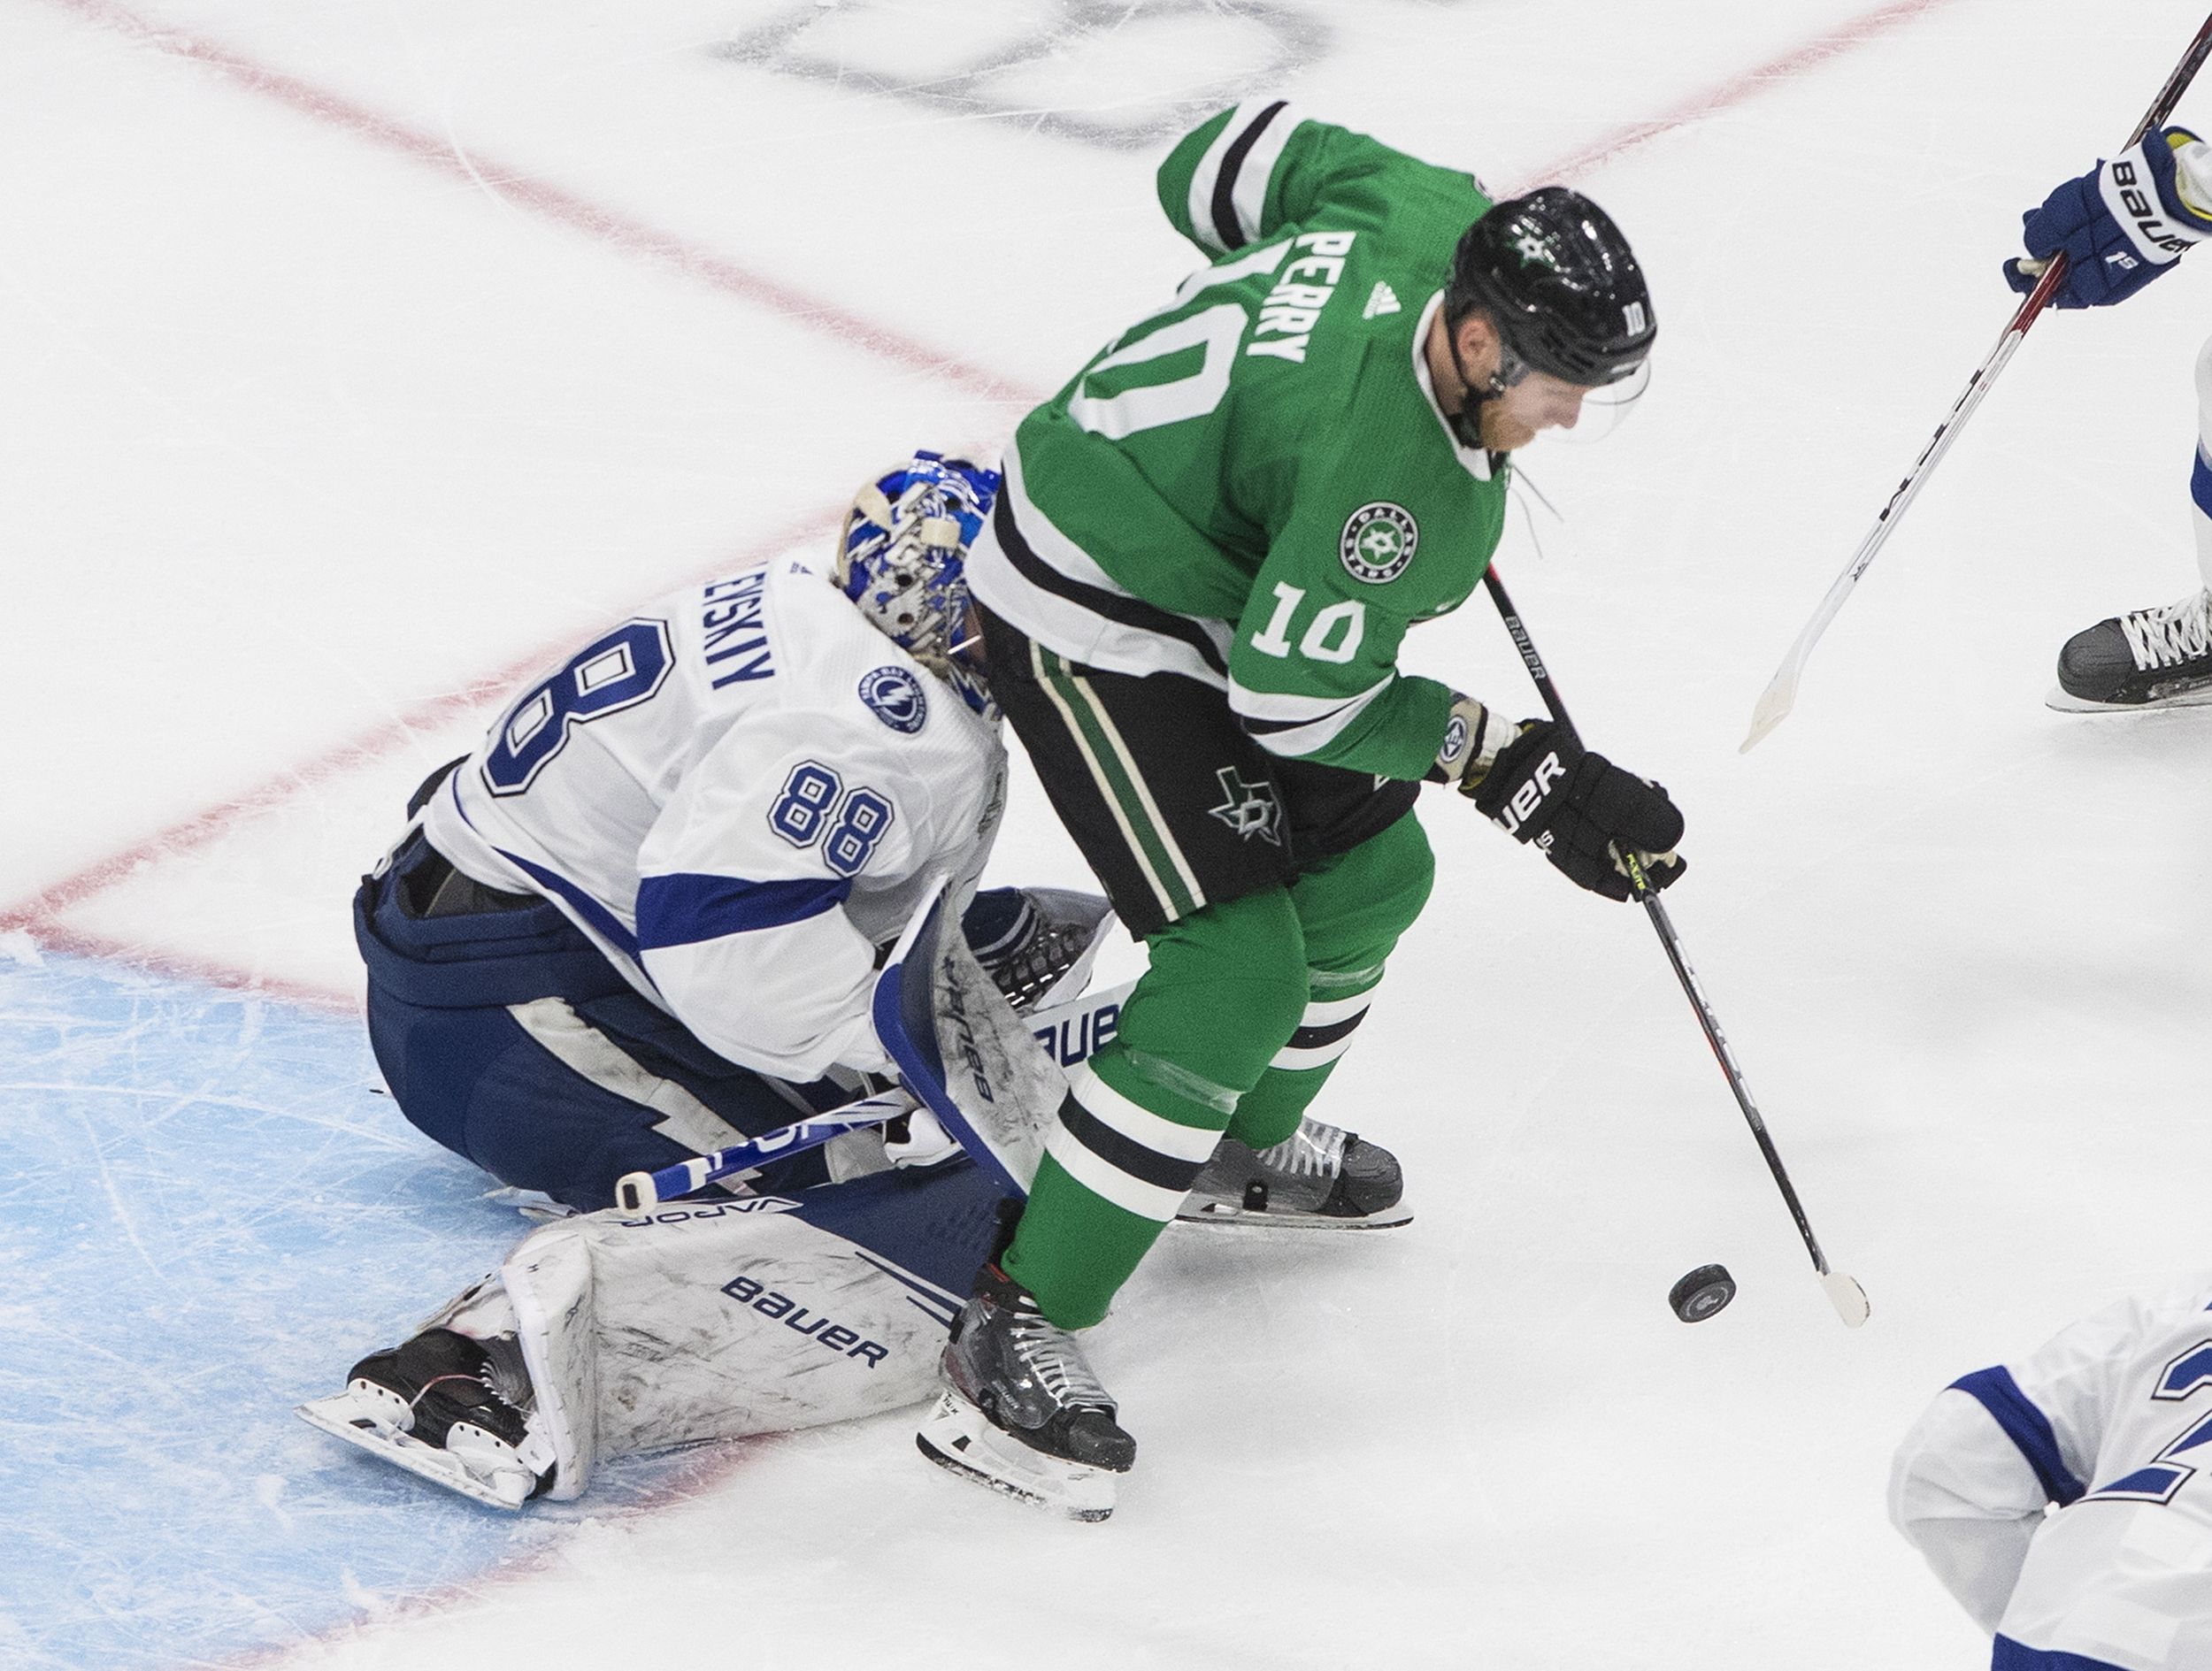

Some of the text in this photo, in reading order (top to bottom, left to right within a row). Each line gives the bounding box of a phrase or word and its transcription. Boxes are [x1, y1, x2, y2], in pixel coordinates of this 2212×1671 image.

[1246, 231, 1357, 364] PERRY
[1622, 301, 1646, 336] 10
[1357, 507, 1414, 556] DALLAS
[703, 562, 776, 690] EVSKIY
[1249, 580, 1367, 665] 10
[766, 759, 895, 878] 88
[620, 1199, 796, 1228] VAPOR
